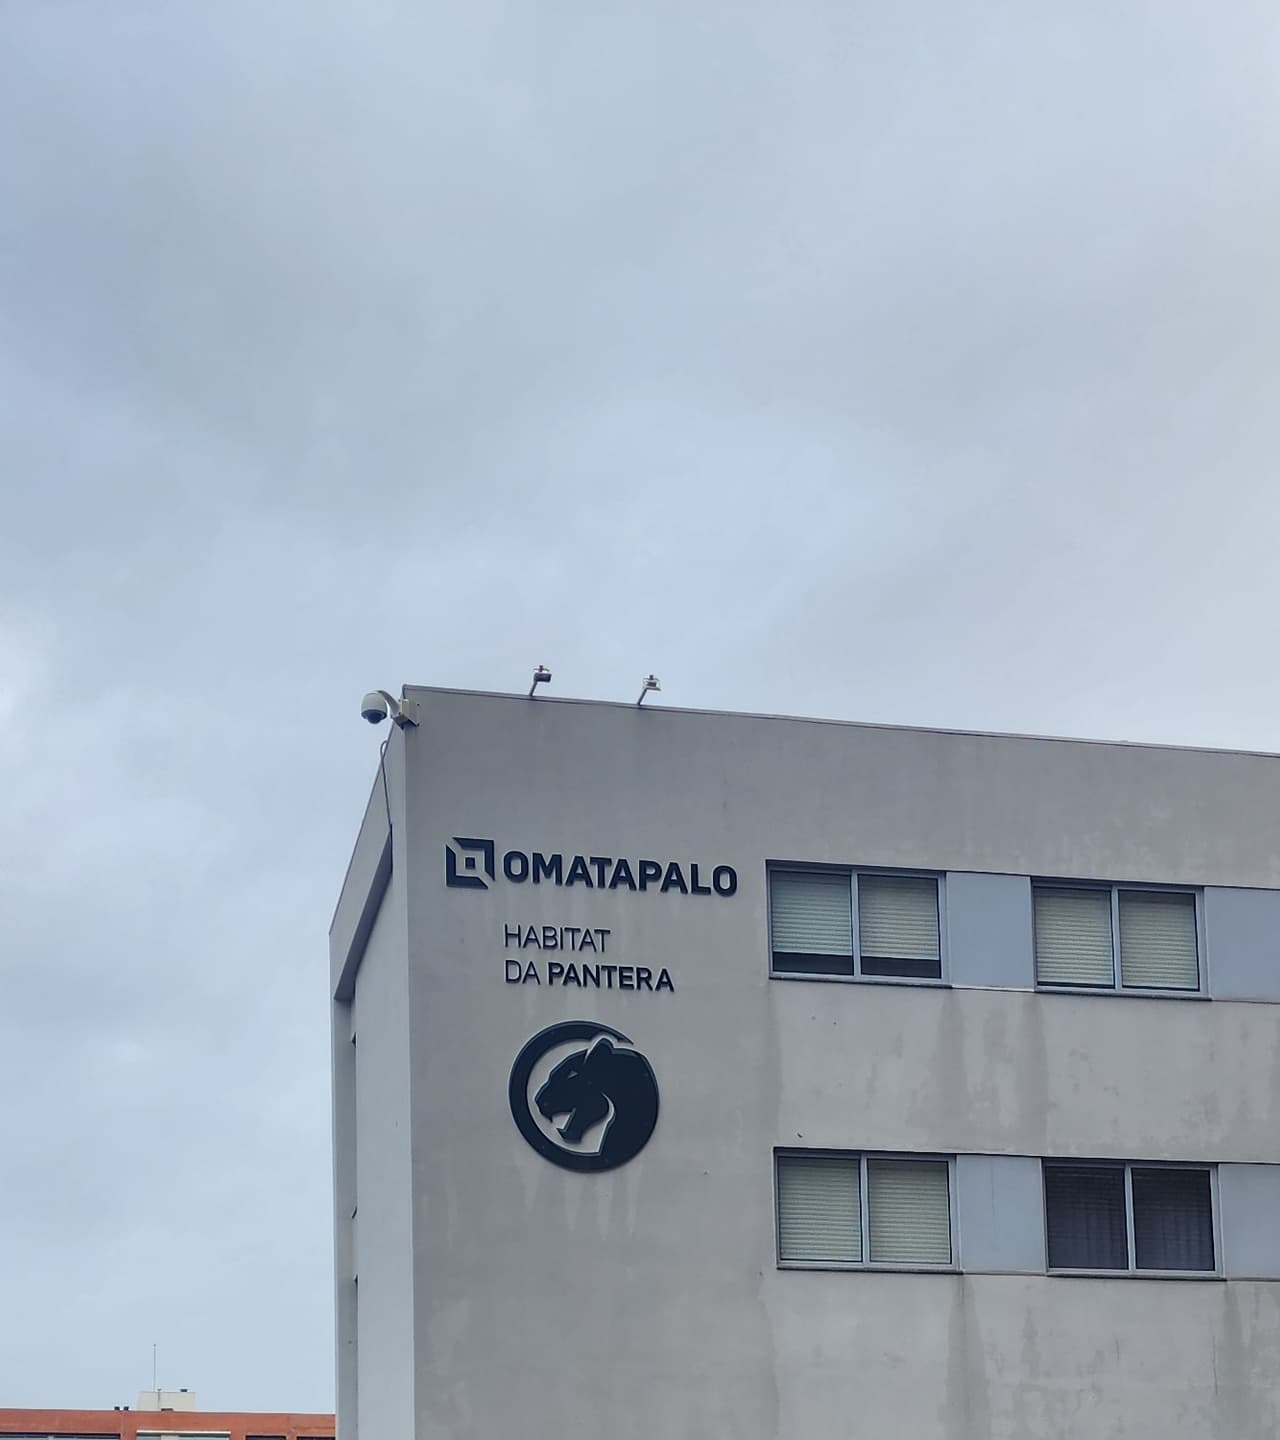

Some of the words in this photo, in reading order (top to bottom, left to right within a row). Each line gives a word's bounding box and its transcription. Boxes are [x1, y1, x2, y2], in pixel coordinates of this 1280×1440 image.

[503, 850, 738, 897] OMATAPALO
[504, 923, 611, 953] HABITAT
[504, 959, 541, 986] DA
[547, 961, 675, 993] PANTERA
